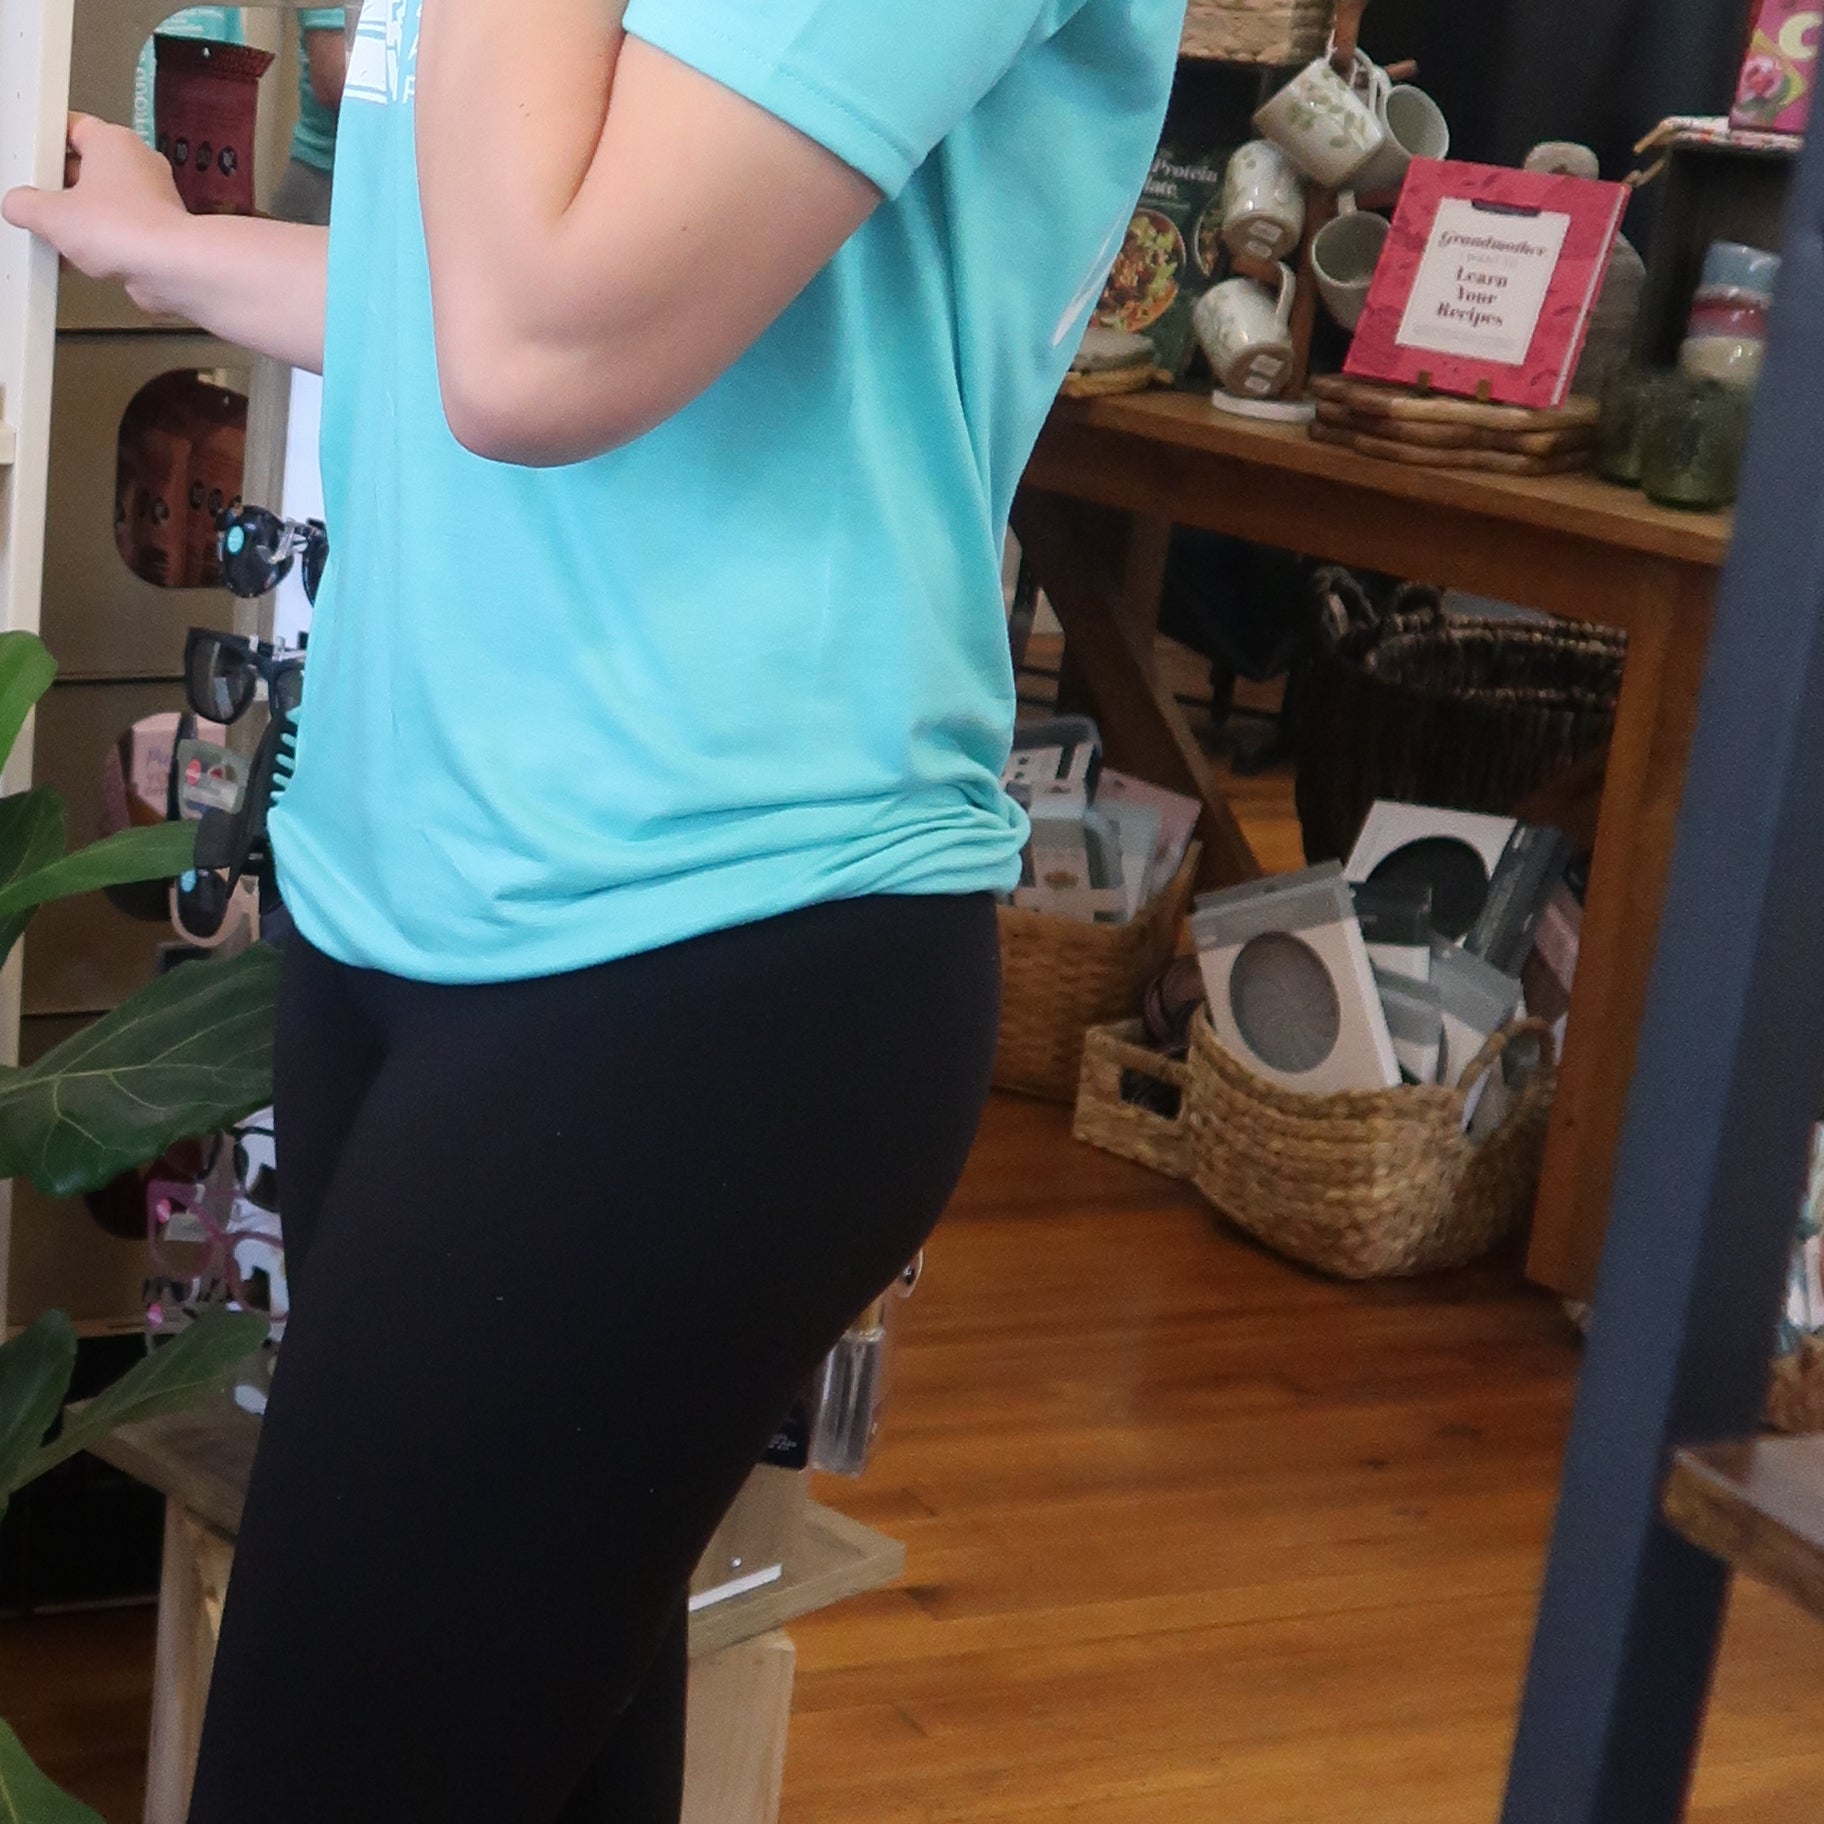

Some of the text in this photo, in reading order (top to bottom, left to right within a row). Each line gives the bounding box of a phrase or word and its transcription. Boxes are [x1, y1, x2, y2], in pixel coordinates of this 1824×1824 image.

[1455, 267, 1508, 290] Learn
[1457, 286, 1497, 307] Your
[1436, 300, 1505, 328] Recipes
